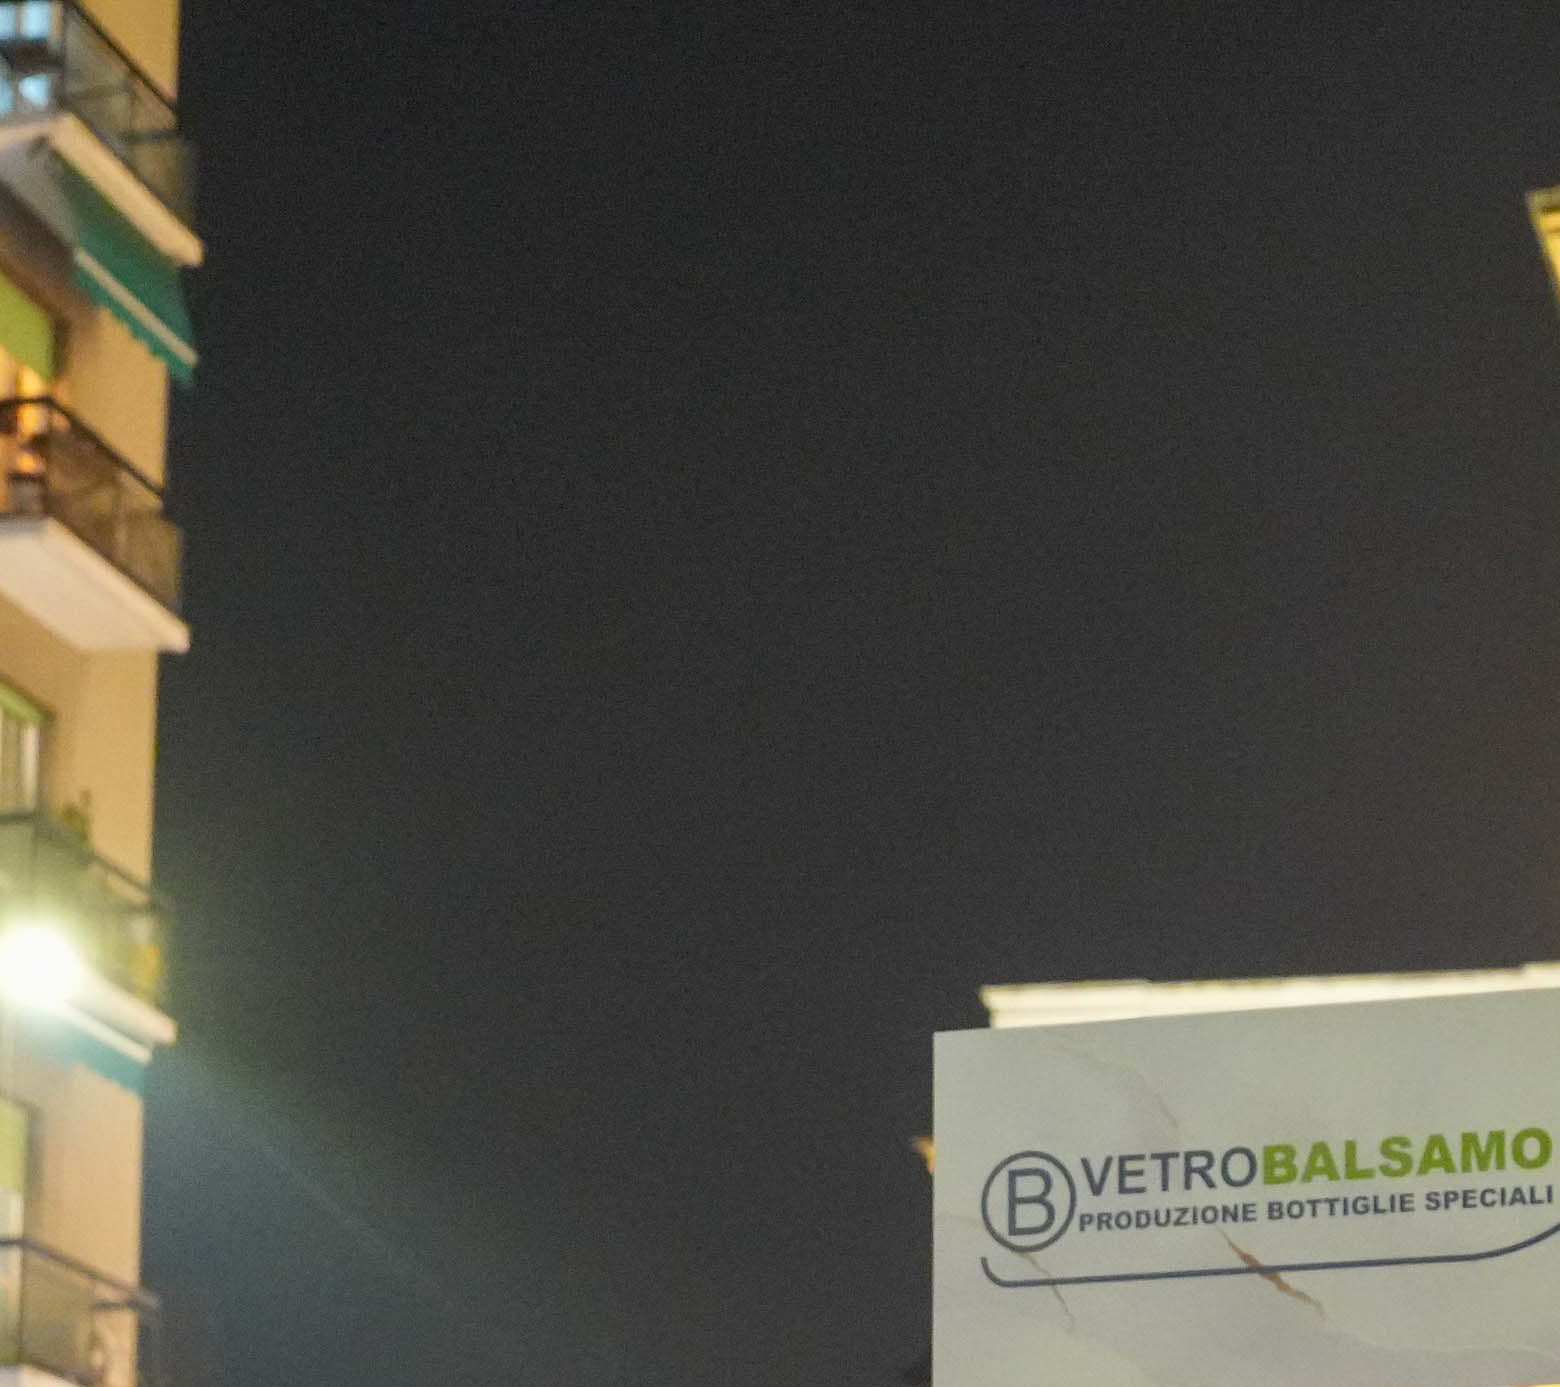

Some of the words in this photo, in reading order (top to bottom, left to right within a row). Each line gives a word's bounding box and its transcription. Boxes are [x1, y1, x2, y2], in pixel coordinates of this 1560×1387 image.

[1080, 1126, 1553, 1197] VETROBALSAMO
[1079, 1202, 1257, 1232] PRODUZIONE
[1267, 1192, 1415, 1221] BOTTIGLIE
[1425, 1184, 1554, 1212] SPECIALI
